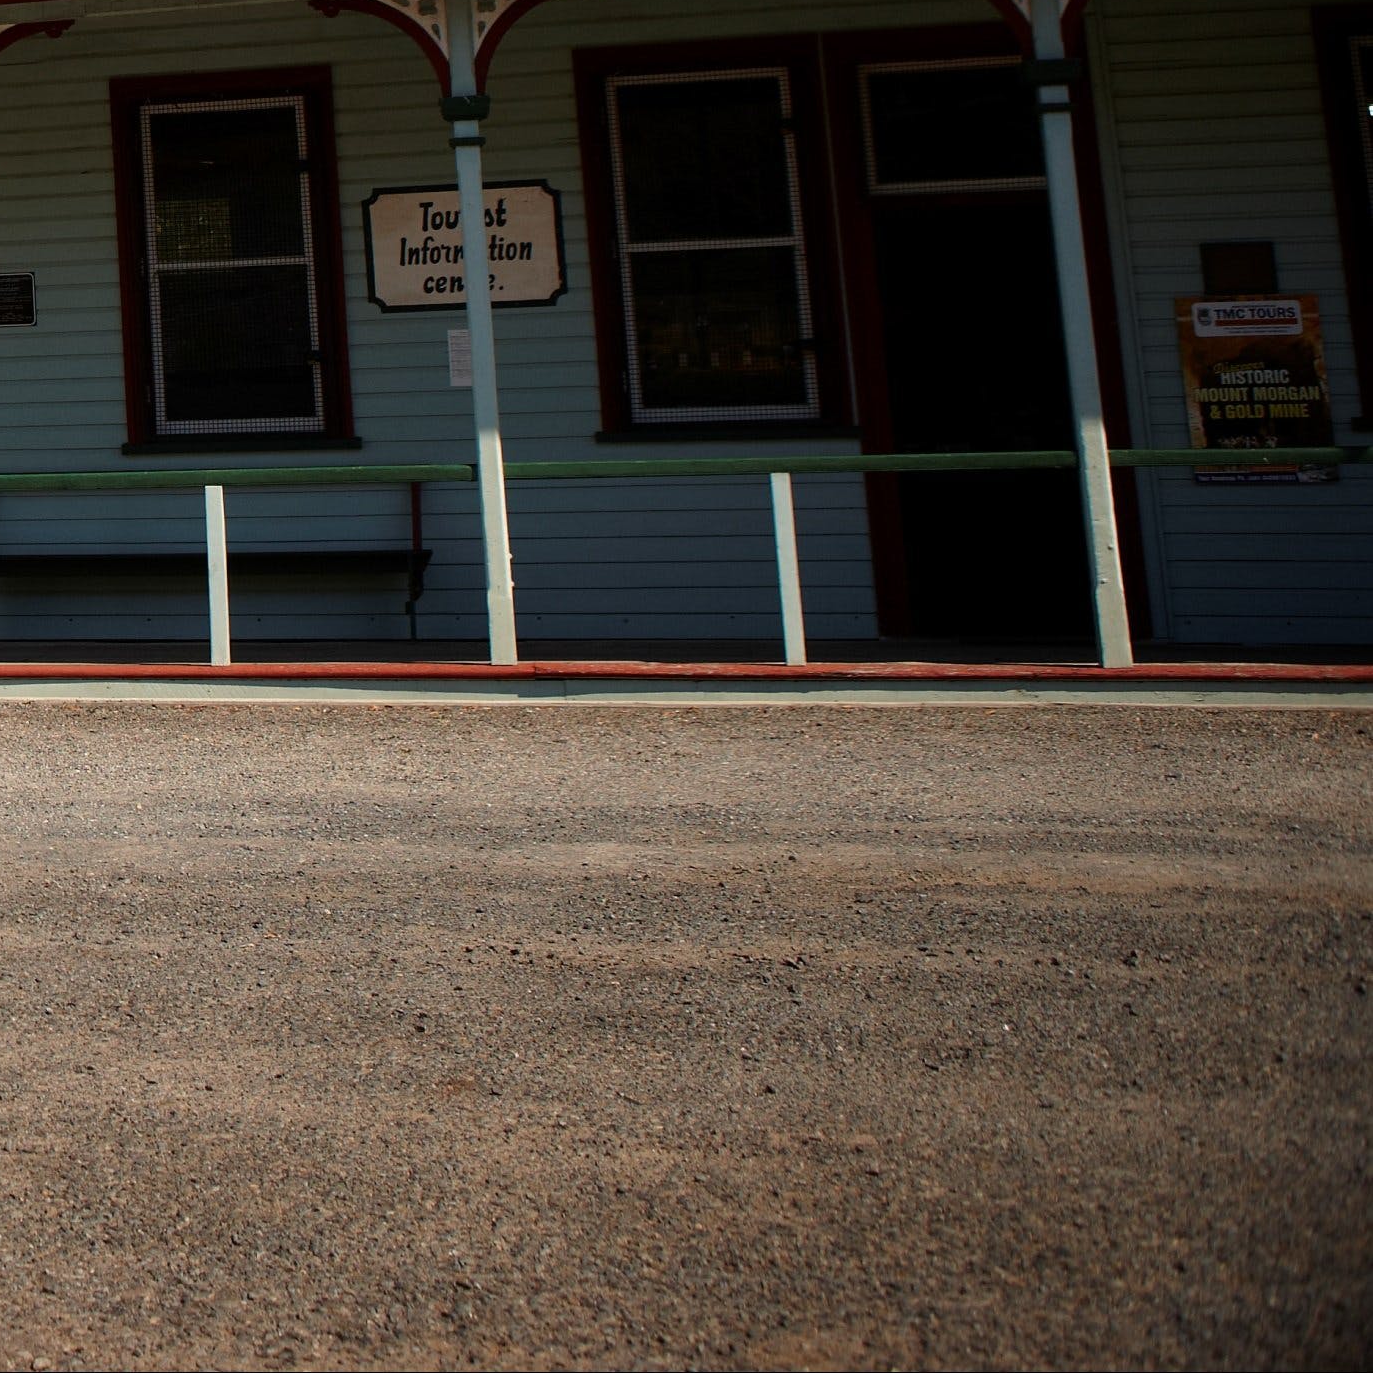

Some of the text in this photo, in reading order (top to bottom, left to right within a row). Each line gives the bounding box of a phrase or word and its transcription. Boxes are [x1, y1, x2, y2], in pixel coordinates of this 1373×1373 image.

[419, 197, 507, 231] Toust
[399, 234, 533, 267] Informtion
[1213, 307, 1296, 320] TMC TOURS
[1221, 369, 1290, 385] HISTORIC
[1195, 386, 1321, 403] MOUNT MORGAN
[1209, 403, 1312, 419] & GOLD MINE
